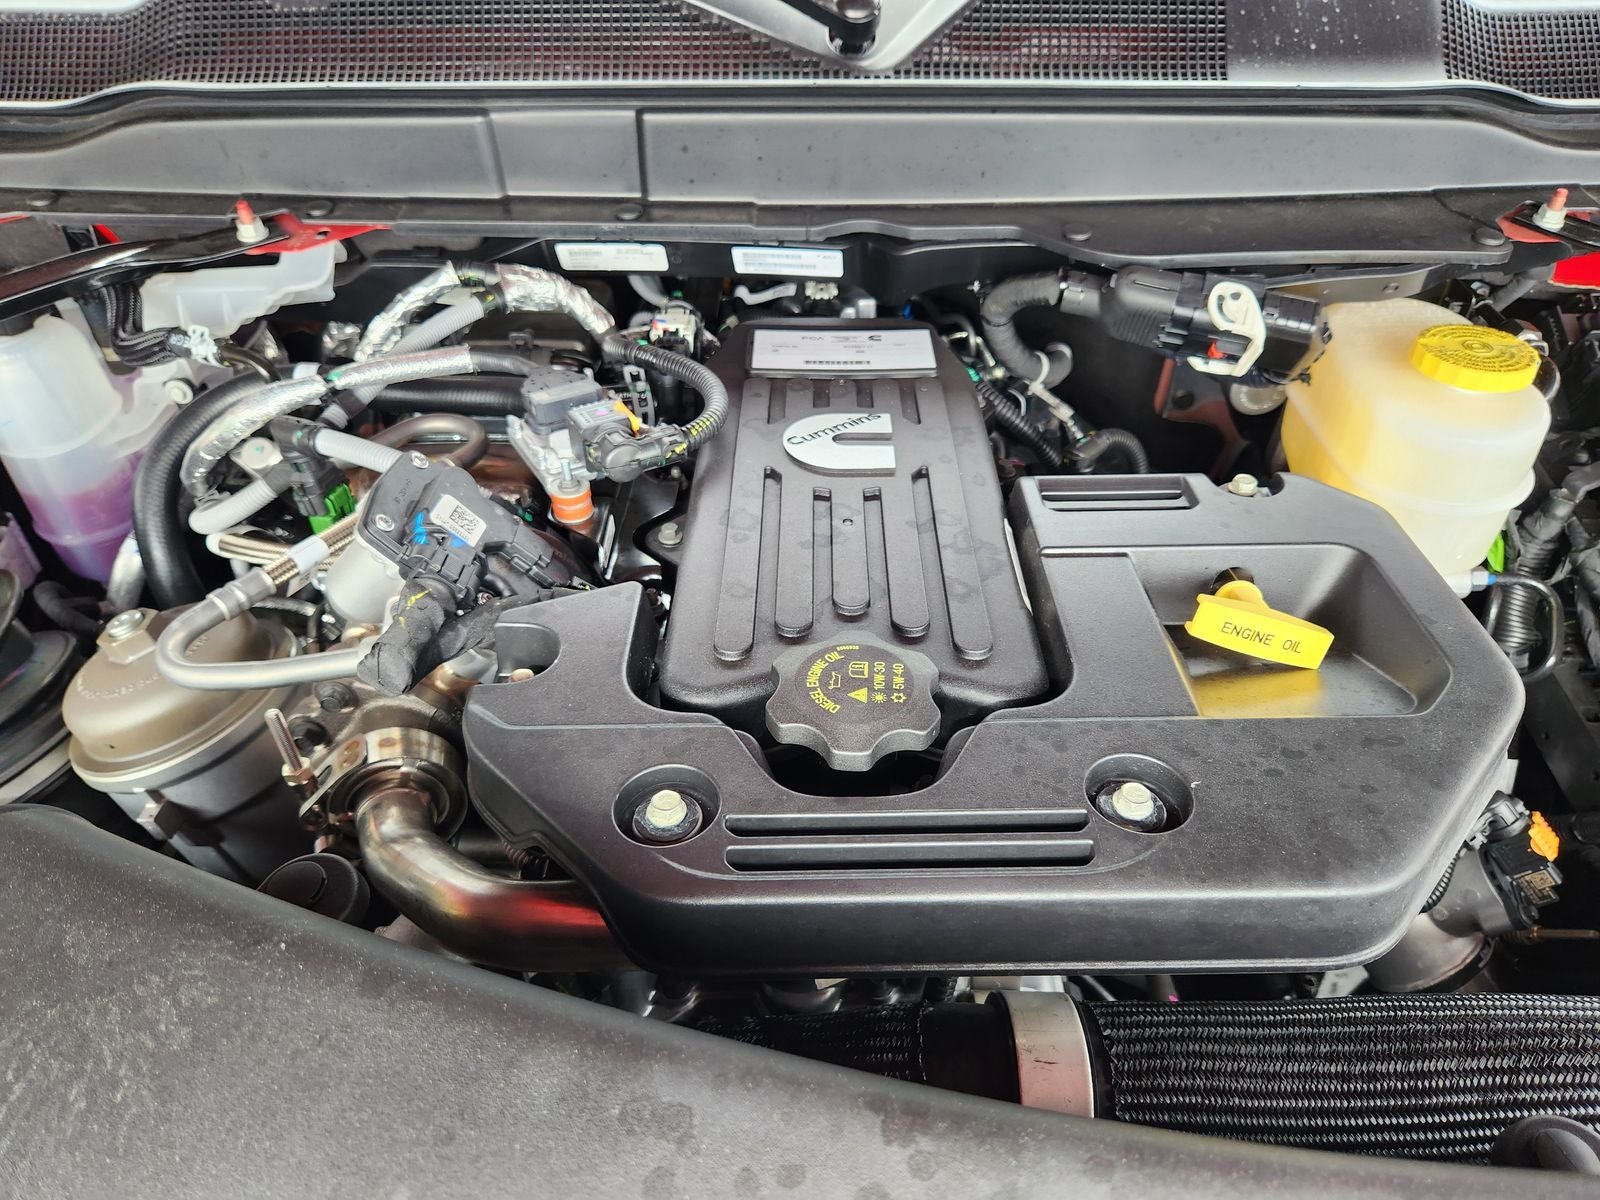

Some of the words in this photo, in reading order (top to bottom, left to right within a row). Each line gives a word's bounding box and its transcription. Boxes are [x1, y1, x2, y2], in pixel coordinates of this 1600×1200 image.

[786, 413, 881, 445] Cummins
[1220, 621, 1275, 646] ENGINE
[1282, 639, 1302, 654] OIL
[824, 651, 845, 664] OIL
[806, 659, 829, 688] ENGINE
[873, 661, 886, 690] 10W-30
[892, 663, 905, 690] 5W-40
[809, 688, 841, 714] DIESEL
